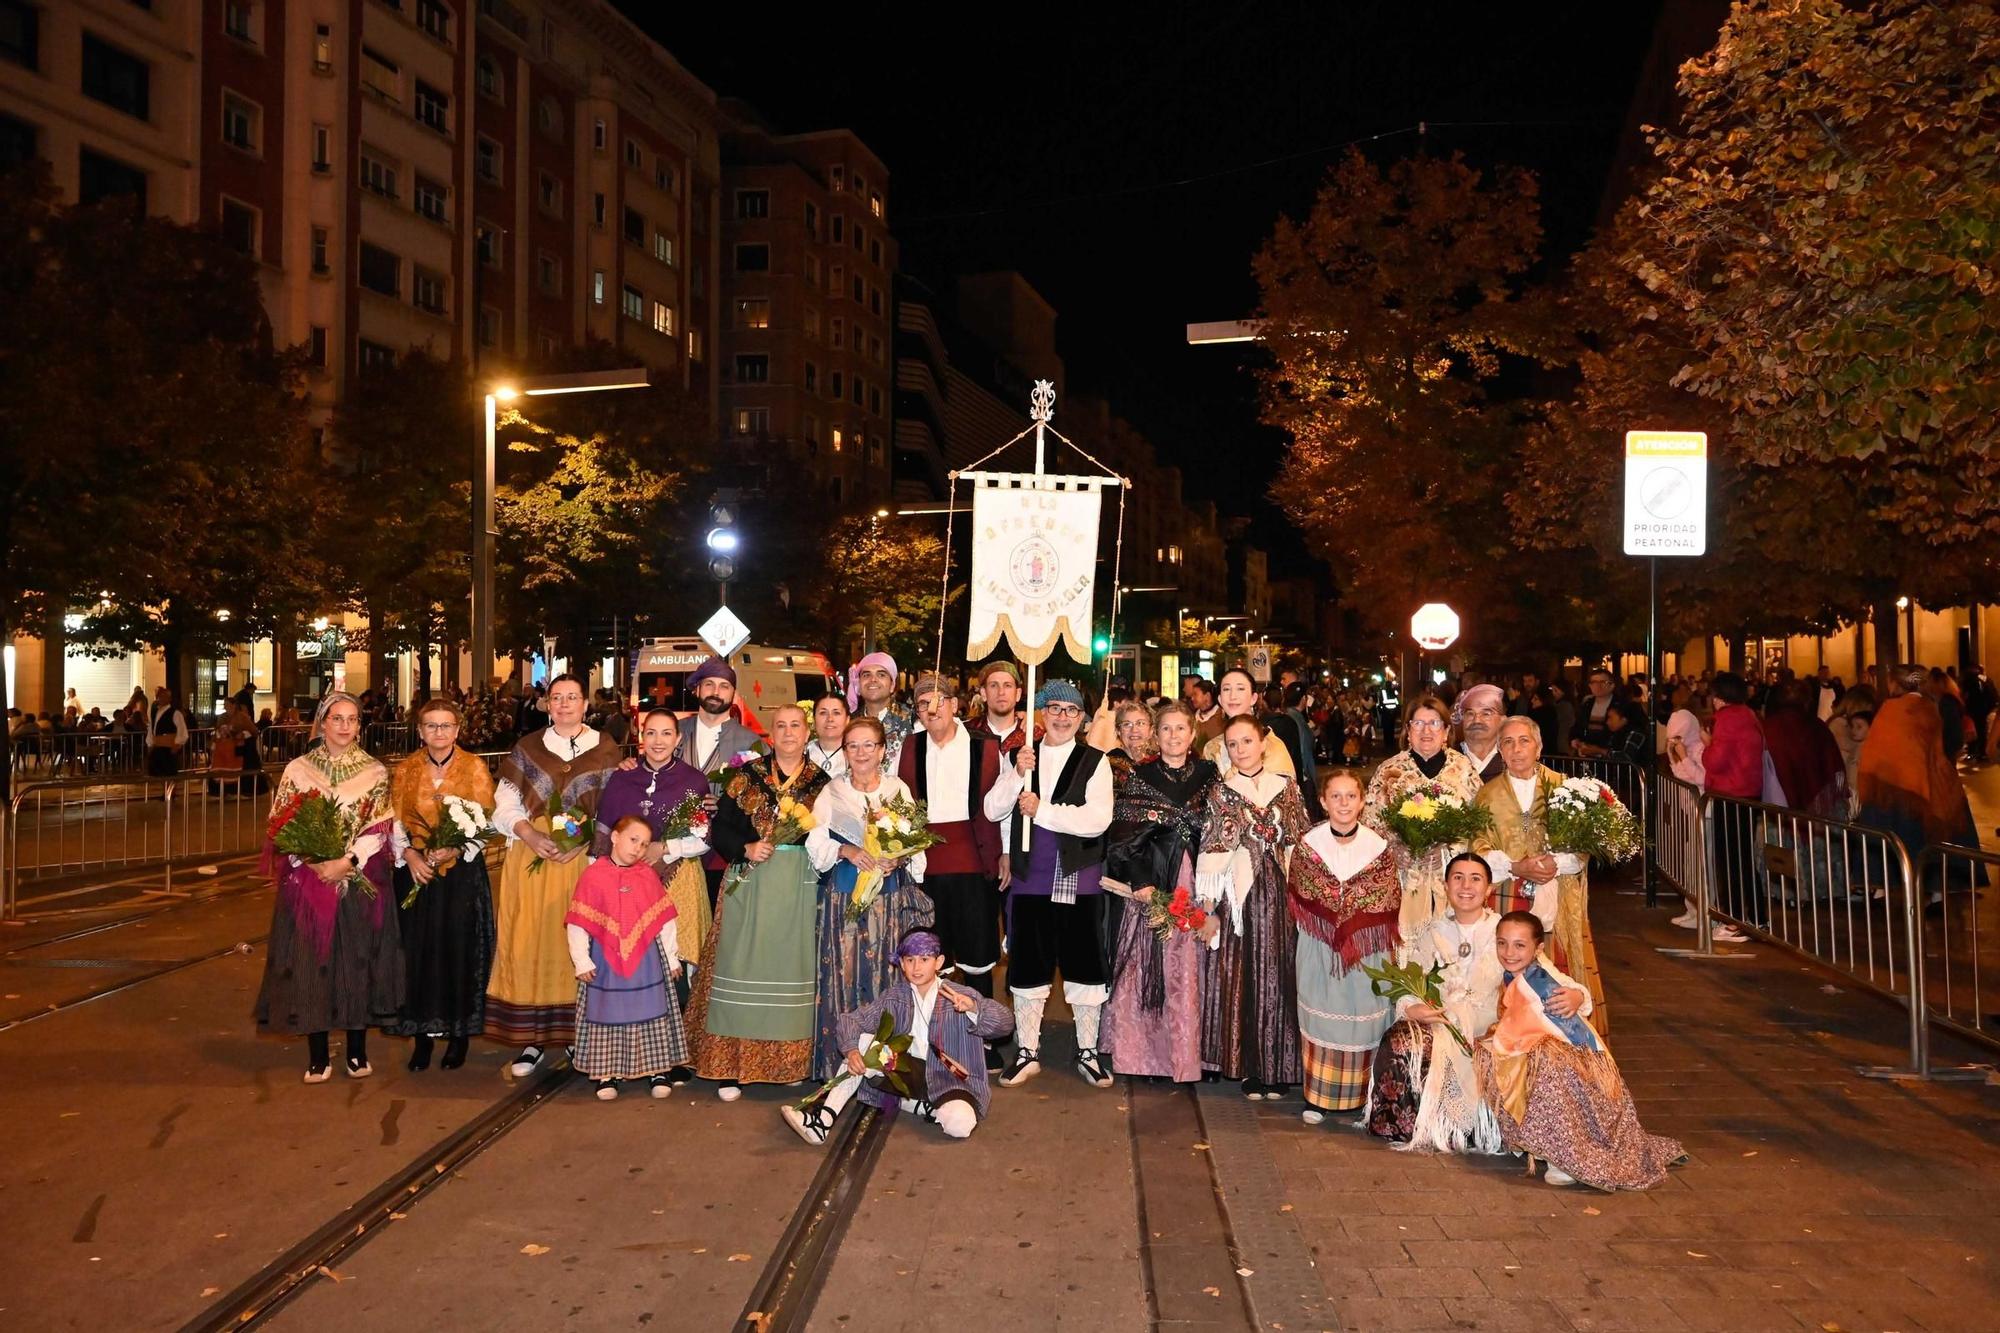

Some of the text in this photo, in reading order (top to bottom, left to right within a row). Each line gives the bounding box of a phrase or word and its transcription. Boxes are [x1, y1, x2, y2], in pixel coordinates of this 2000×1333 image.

[1634, 524, 1697, 533] PRIORIDAD
[1635, 538, 1695, 547] PEATONAL
[713, 623, 735, 640] 30
[650, 654, 710, 665] AMBULANC
